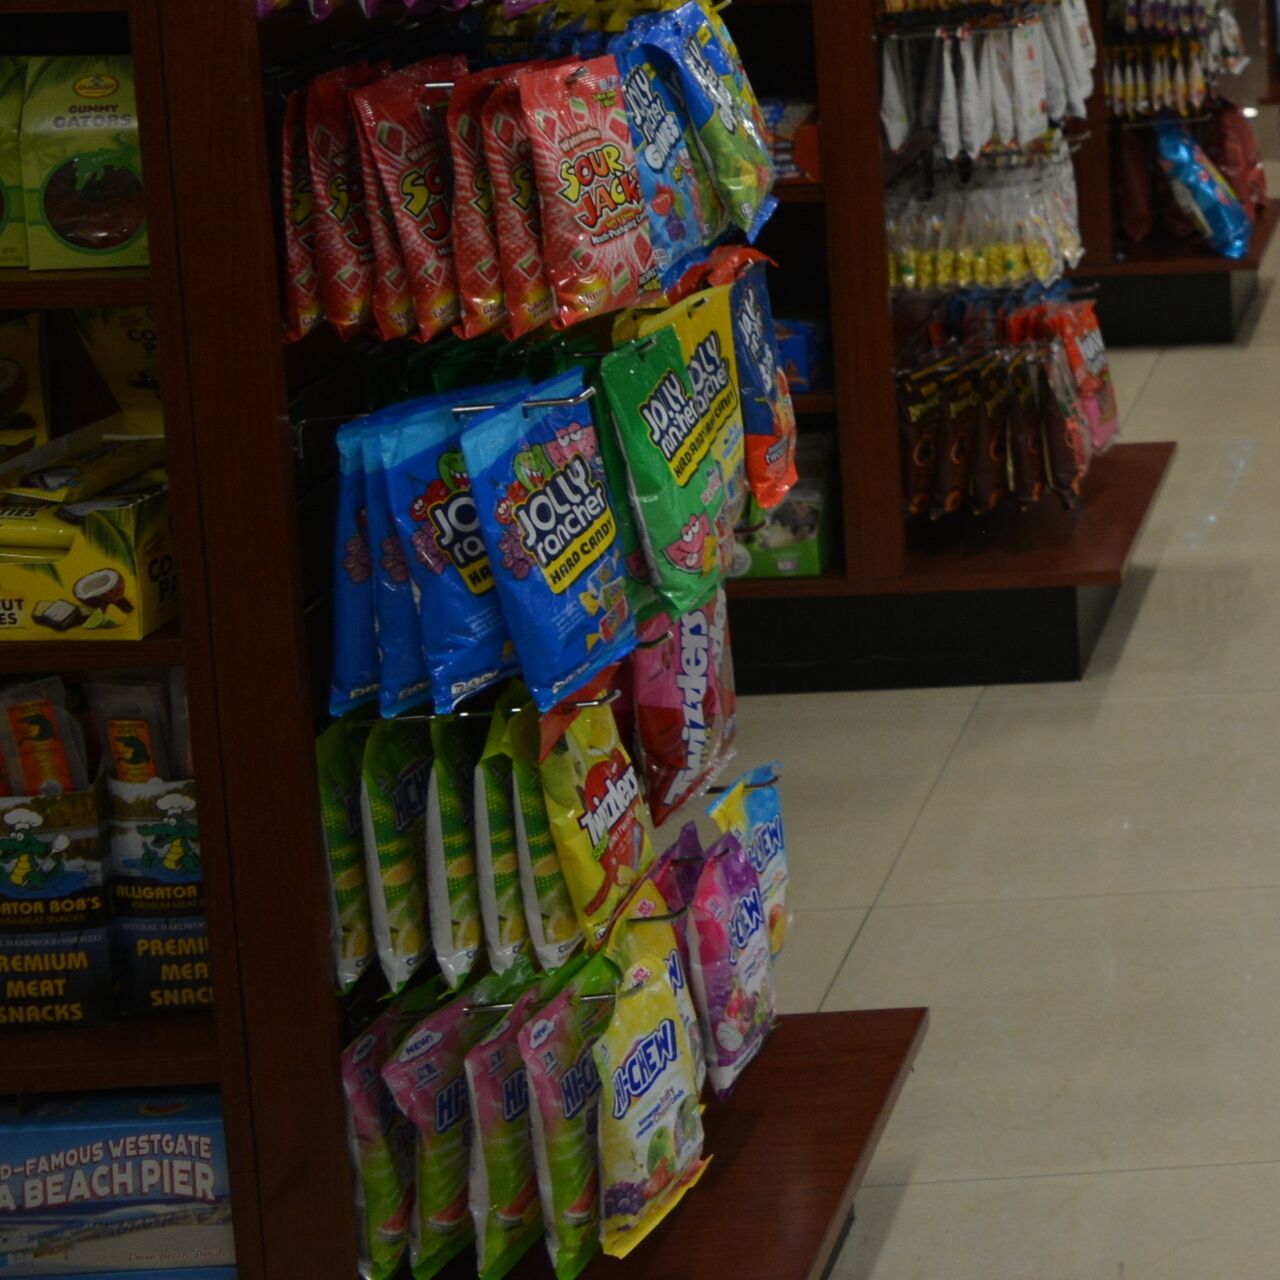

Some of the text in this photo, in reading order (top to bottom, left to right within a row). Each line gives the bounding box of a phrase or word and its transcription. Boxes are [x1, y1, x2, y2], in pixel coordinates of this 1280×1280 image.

[68, 103, 119, 115] GUMMY
[52, 114, 134, 129] GATORS
[558, 145, 625, 203] SOUR
[519, 459, 591, 549] JOLLY
[537, 488, 606, 567] rancher
[550, 522, 615, 586] HARD CANDY
[115, 883, 199, 901] ALLIGATOR
[50, 895, 102, 913] BOB'S
[136, 937, 211, 957] PREMI
[0, 950, 90, 972] REMIUM
[5, 978, 67, 999] MEAT
[150, 985, 215, 1009] SNAC
[0, 1002, 85, 1024] SNACKS
[404, 1034, 435, 1057] NEW!
[612, 1017, 676, 1120] HI-CHEW
[0, 1133, 213, 1182] D-FAMOUS WESTGATE
[23, 1158, 216, 1210] BEACH PIER
